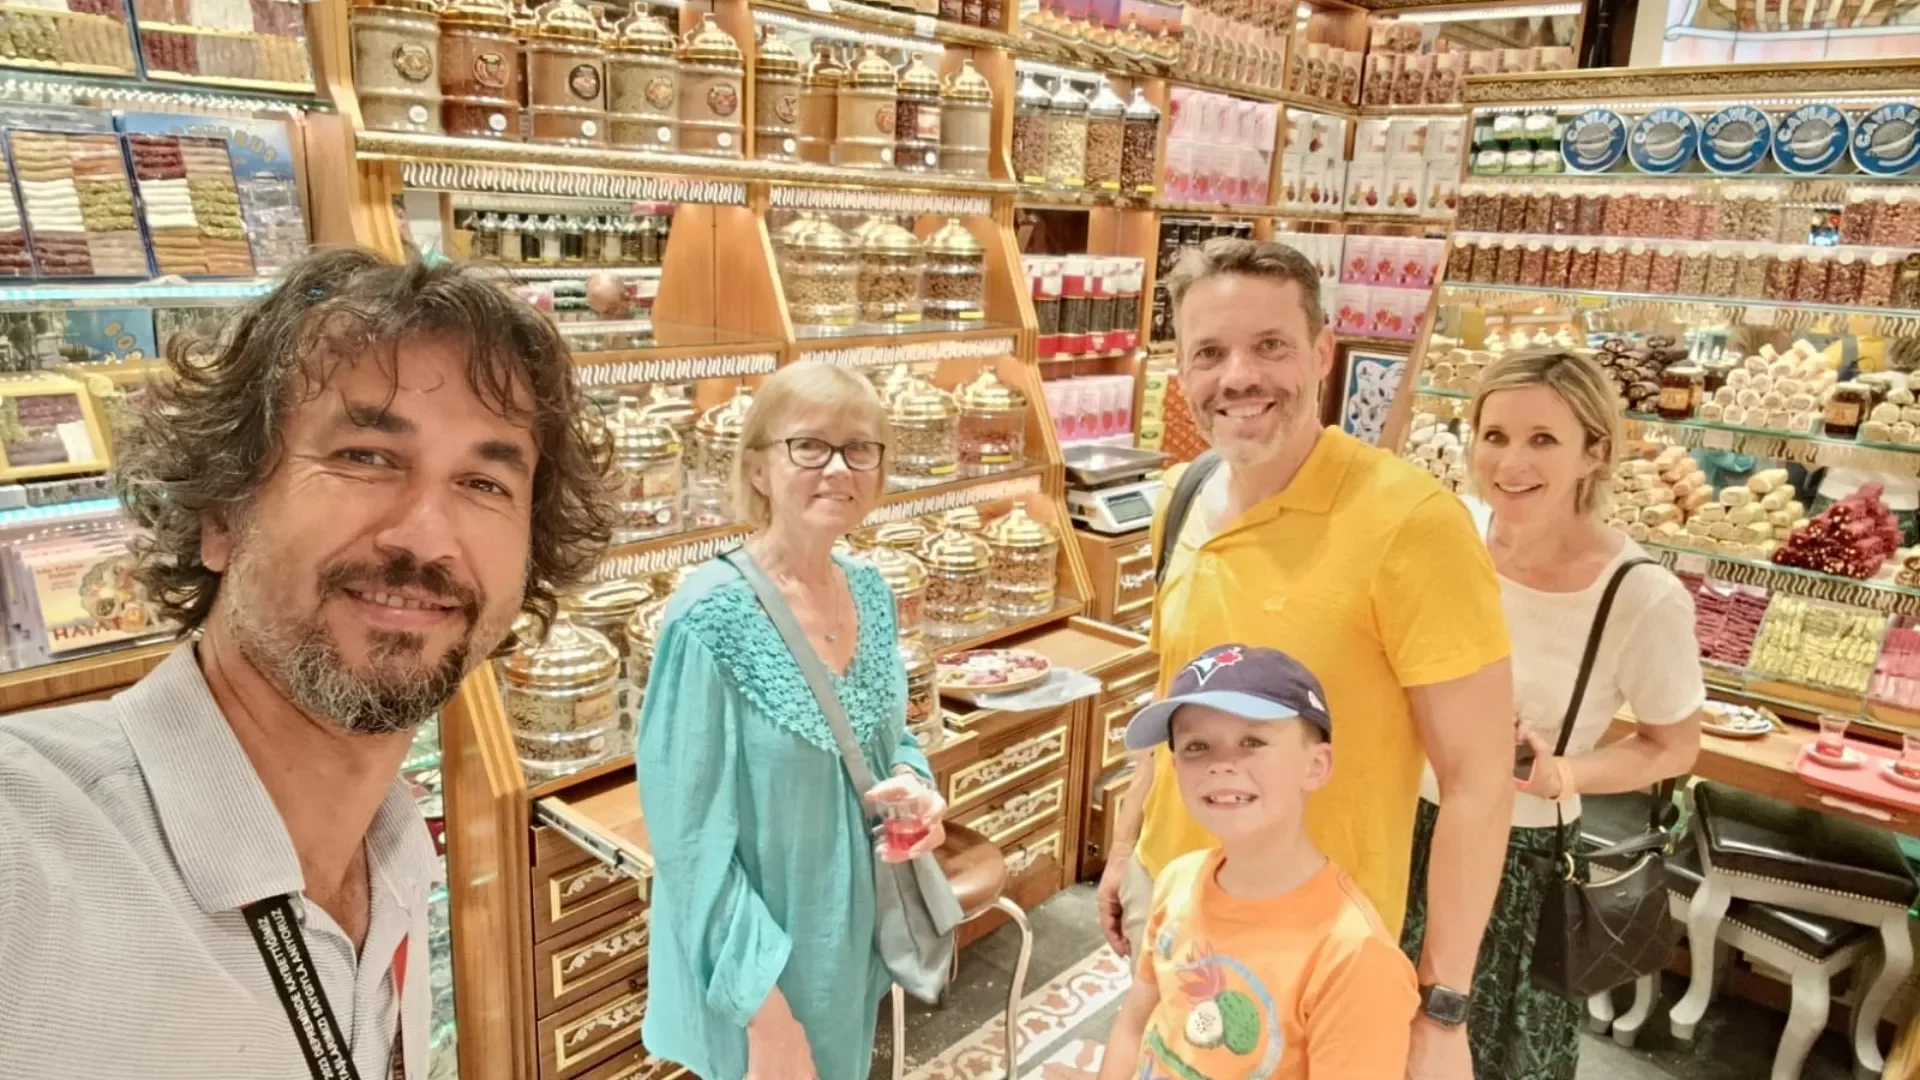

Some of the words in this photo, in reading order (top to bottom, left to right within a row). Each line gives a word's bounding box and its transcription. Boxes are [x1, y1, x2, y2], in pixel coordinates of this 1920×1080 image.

[1566, 111, 1620, 141] CAVIAR
[1633, 109, 1691, 144] CAVIAR
[1705, 107, 1766, 137] CAVIAR
[1777, 106, 1841, 142] CAVIAR
[1855, 105, 1920, 148] CAVIAR
[270, 907, 303, 964] ANIYORUZ
